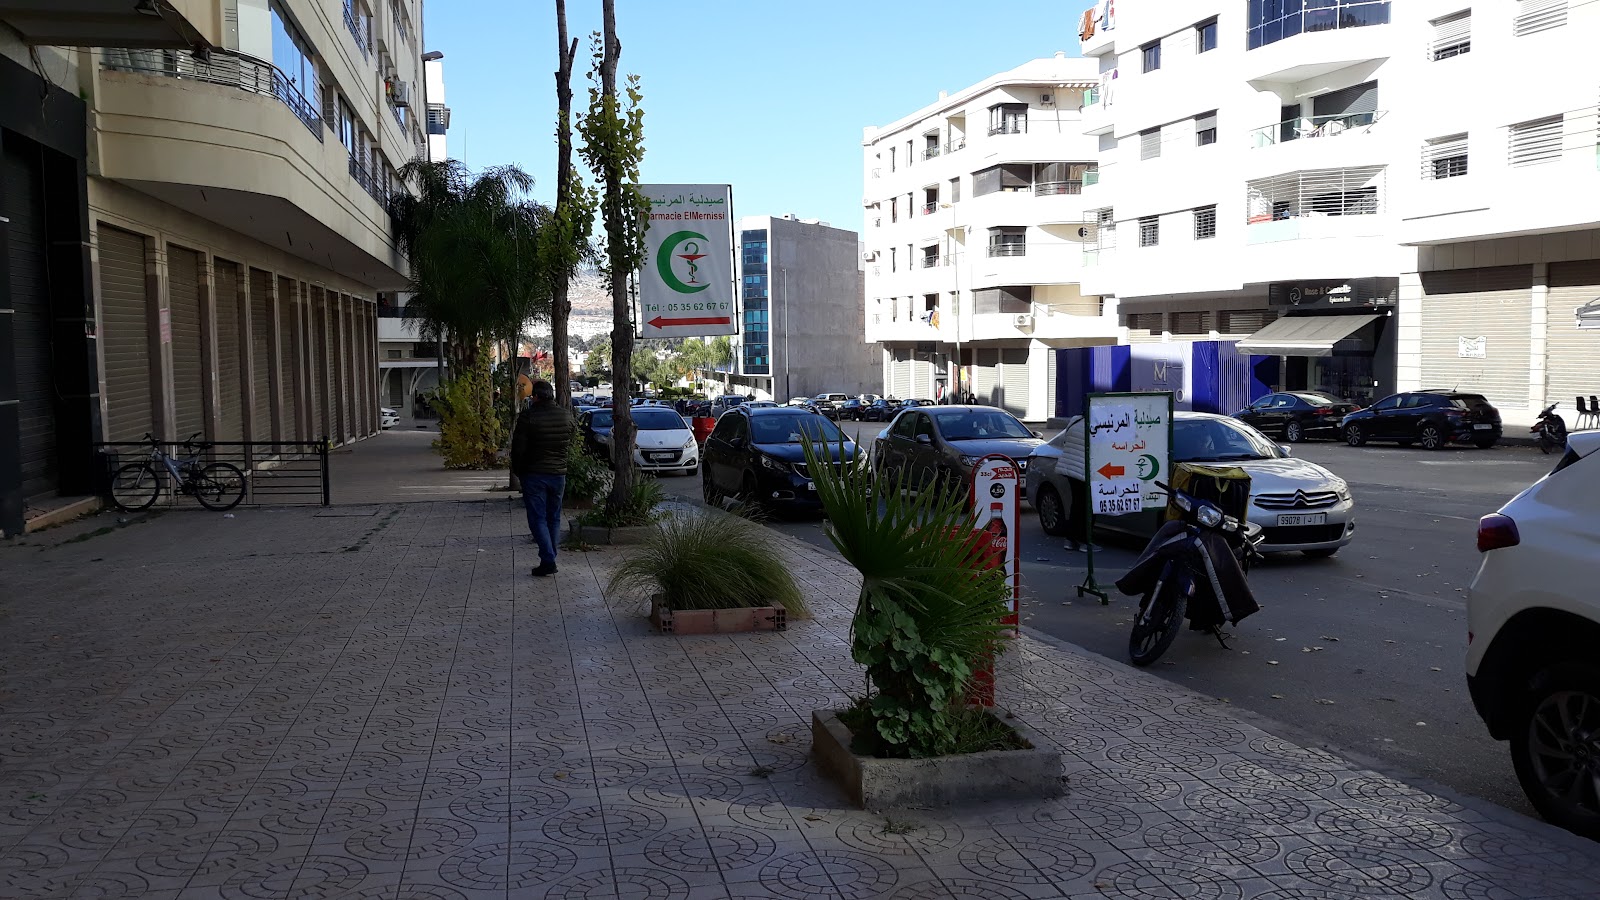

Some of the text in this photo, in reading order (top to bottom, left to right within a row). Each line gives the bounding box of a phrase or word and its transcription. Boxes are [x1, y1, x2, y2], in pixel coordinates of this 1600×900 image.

[649, 192, 724, 207] صيدلية المرنيس
[640, 211, 725, 221] Parmacie ElMernissi
[645, 303, 660, 312] Tél
[667, 303, 679, 311] 05
[680, 303, 691, 311] 35
[706, 302, 717, 310] 67
[719, 302, 729, 310] 67
[1154, 361, 1167, 382] M
[1090, 411, 1130, 438] المرنيسي
[1098, 483, 1139, 498] للحراسة
[1100, 498, 1139, 512] 05 35 62 67 67
